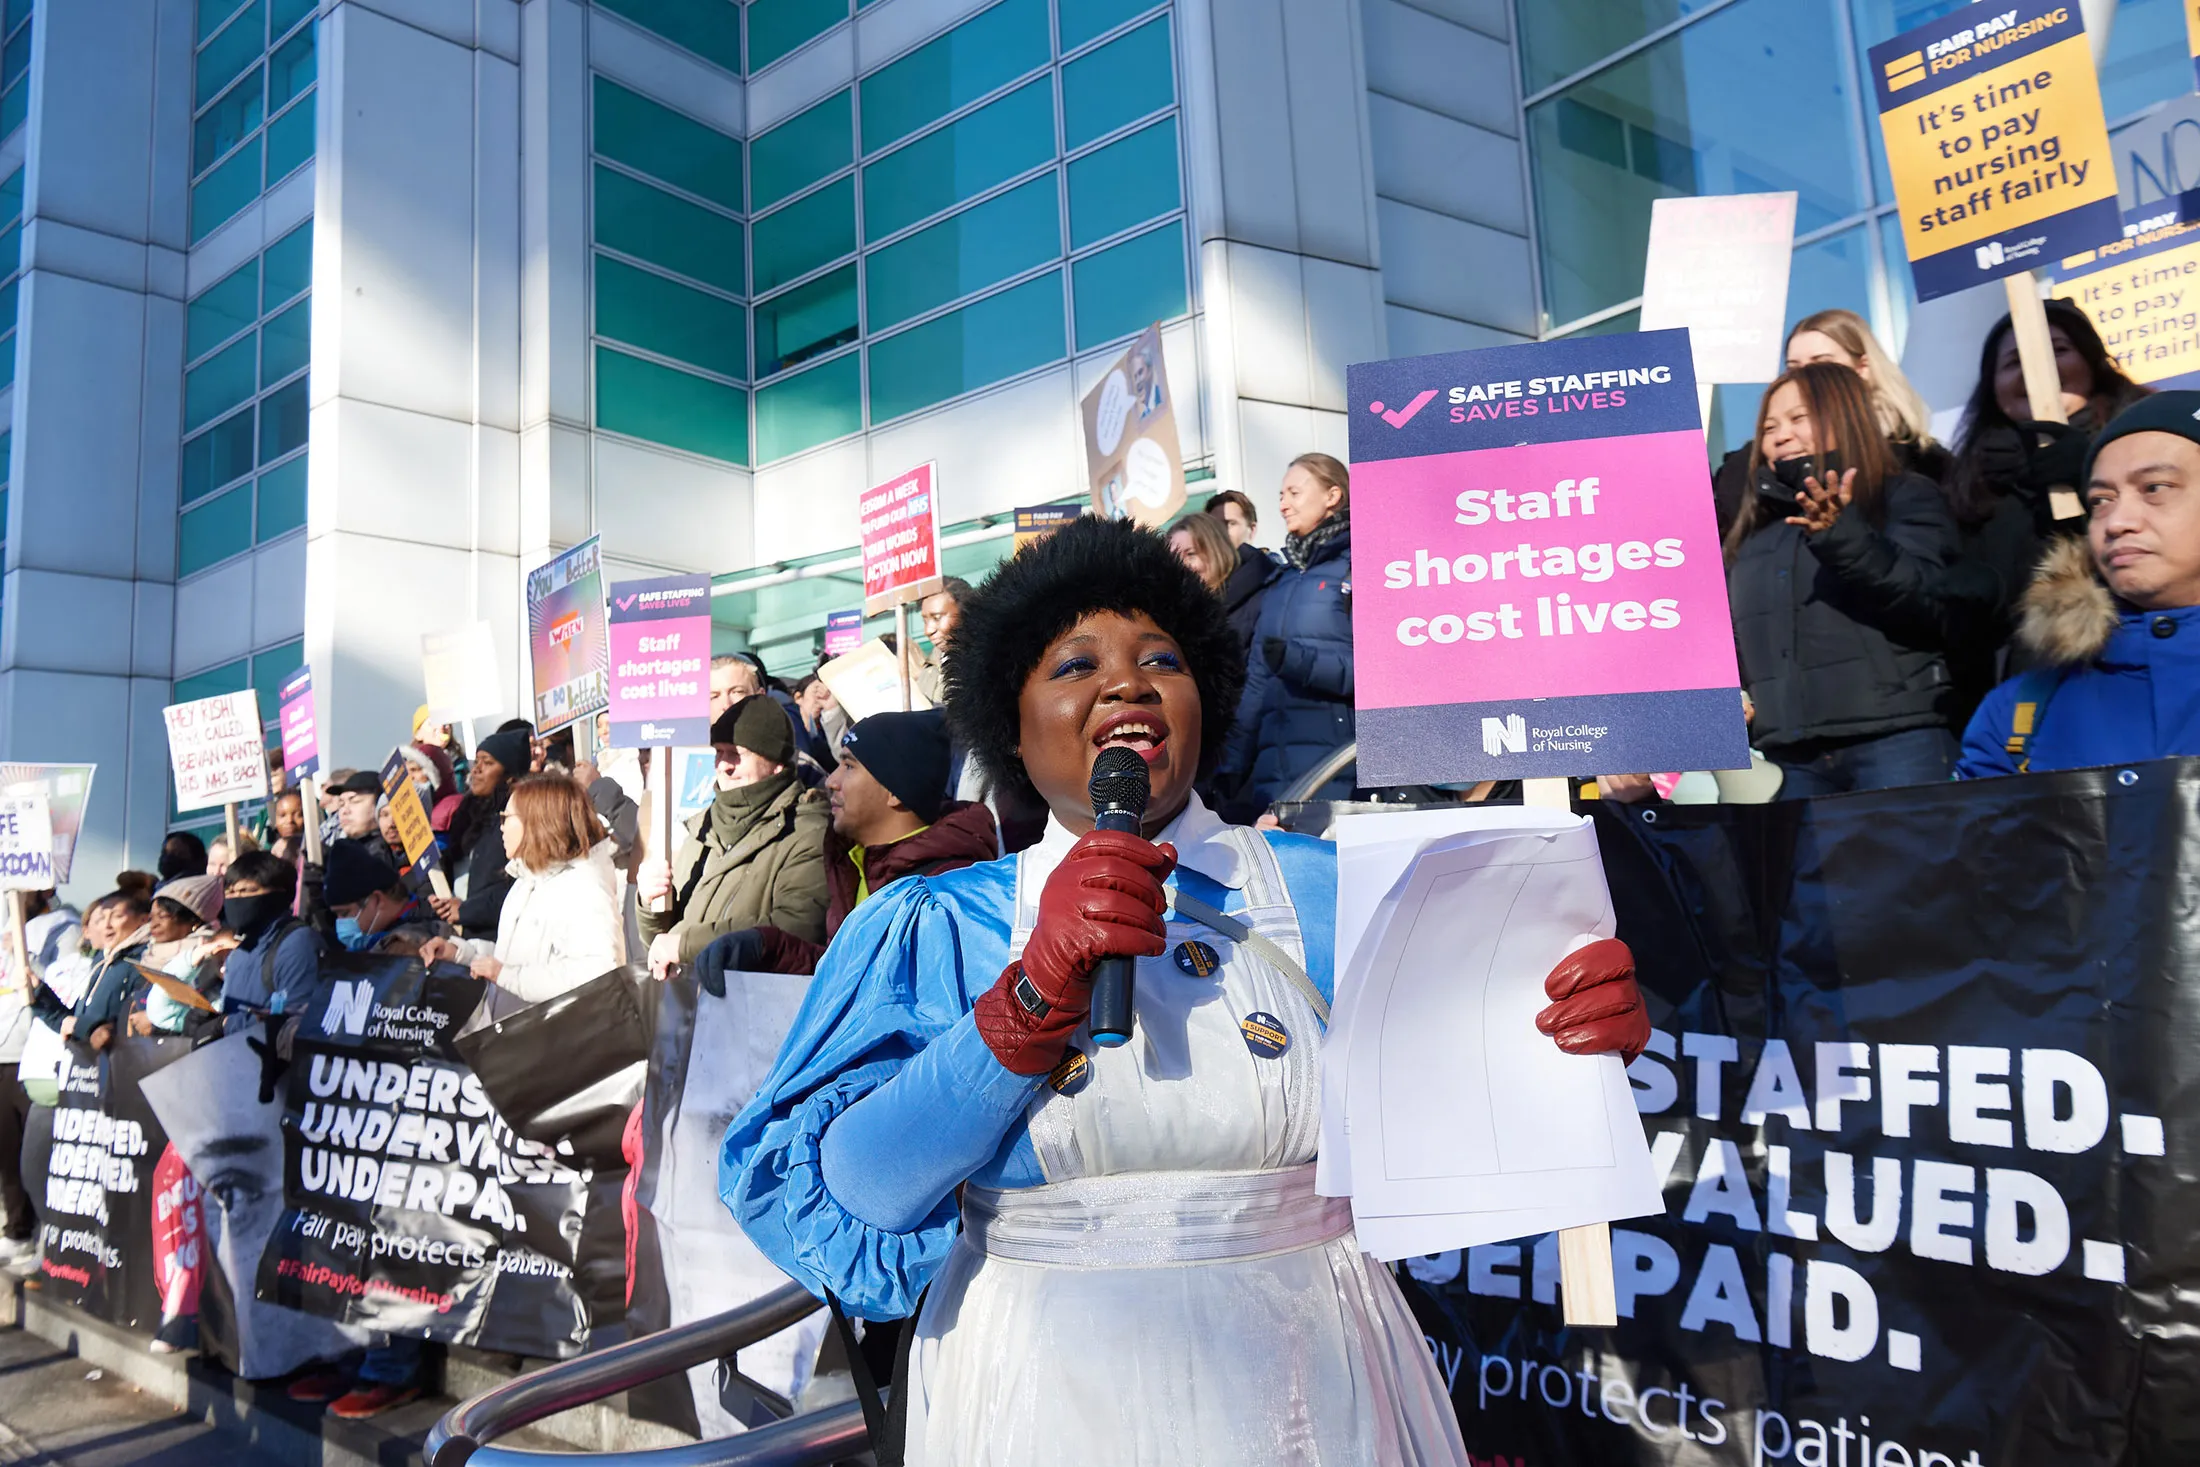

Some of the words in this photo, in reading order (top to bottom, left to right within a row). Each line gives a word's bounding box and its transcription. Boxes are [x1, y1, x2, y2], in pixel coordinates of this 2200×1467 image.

[1926, 30, 1976, 60] FAIR
[1975, 9, 2018, 40] PAY
[1930, 48, 1972, 75] FOR
[1974, 7, 2069, 57] NURSING
[1918, 104, 1966, 135] It's
[1973, 70, 2053, 112] time
[1939, 136, 1972, 159] to
[1981, 107, 2040, 150] pay
[1934, 136, 2061, 195] nursing
[1919, 187, 1992, 232] staff
[2000, 159, 2089, 204] fairly
[2131, 260, 2197, 289] time
[2098, 306, 2124, 323] to
[2135, 289, 2184, 318] pay
[2107, 312, 2197, 346] ursing
[2144, 333, 2200, 362] fairl
[1448, 381, 1523, 405] SAFE
[1528, 365, 1672, 397] STAFFING
[1450, 400, 1540, 424] SAVES
[1548, 390, 1627, 414] LIVES
[894, 478, 919, 501] WEEK
[1454, 477, 1601, 526] Staff
[907, 496, 929, 517] NHS
[886, 527, 918, 551] WORDS
[866, 555, 900, 583] ACTION
[900, 546, 928, 570] NOW
[1383, 538, 1685, 590] shortages
[662, 587, 704, 600] STAFFING
[552, 619, 582, 644] WHEN
[1396, 604, 1523, 648] cost
[1537, 592, 1682, 638] lives
[638, 633, 681, 653] Staff
[617, 657, 701, 677] shortages
[620, 683, 656, 699] cost
[658, 679, 698, 697] lives
[169, 704, 194, 730] HEY
[1532, 726, 1564, 741] Royal
[1565, 724, 1608, 739] College
[222, 740, 263, 762] WANTS
[1532, 740, 1545, 752] of
[1547, 739, 1593, 753] Nursing
[372, 1003, 405, 1024] Royal
[367, 1021, 382, 1038] of
[383, 1024, 434, 1047] Nursing
[1250, 1024, 1284, 1042] SUPPORT
[1626, 1027, 2165, 1157] STAFFED.
[291, 1207, 332, 1240] Fair
[331, 1223, 366, 1257] pay
[370, 1232, 487, 1269] protects
[1479, 1347, 1728, 1446] protects
